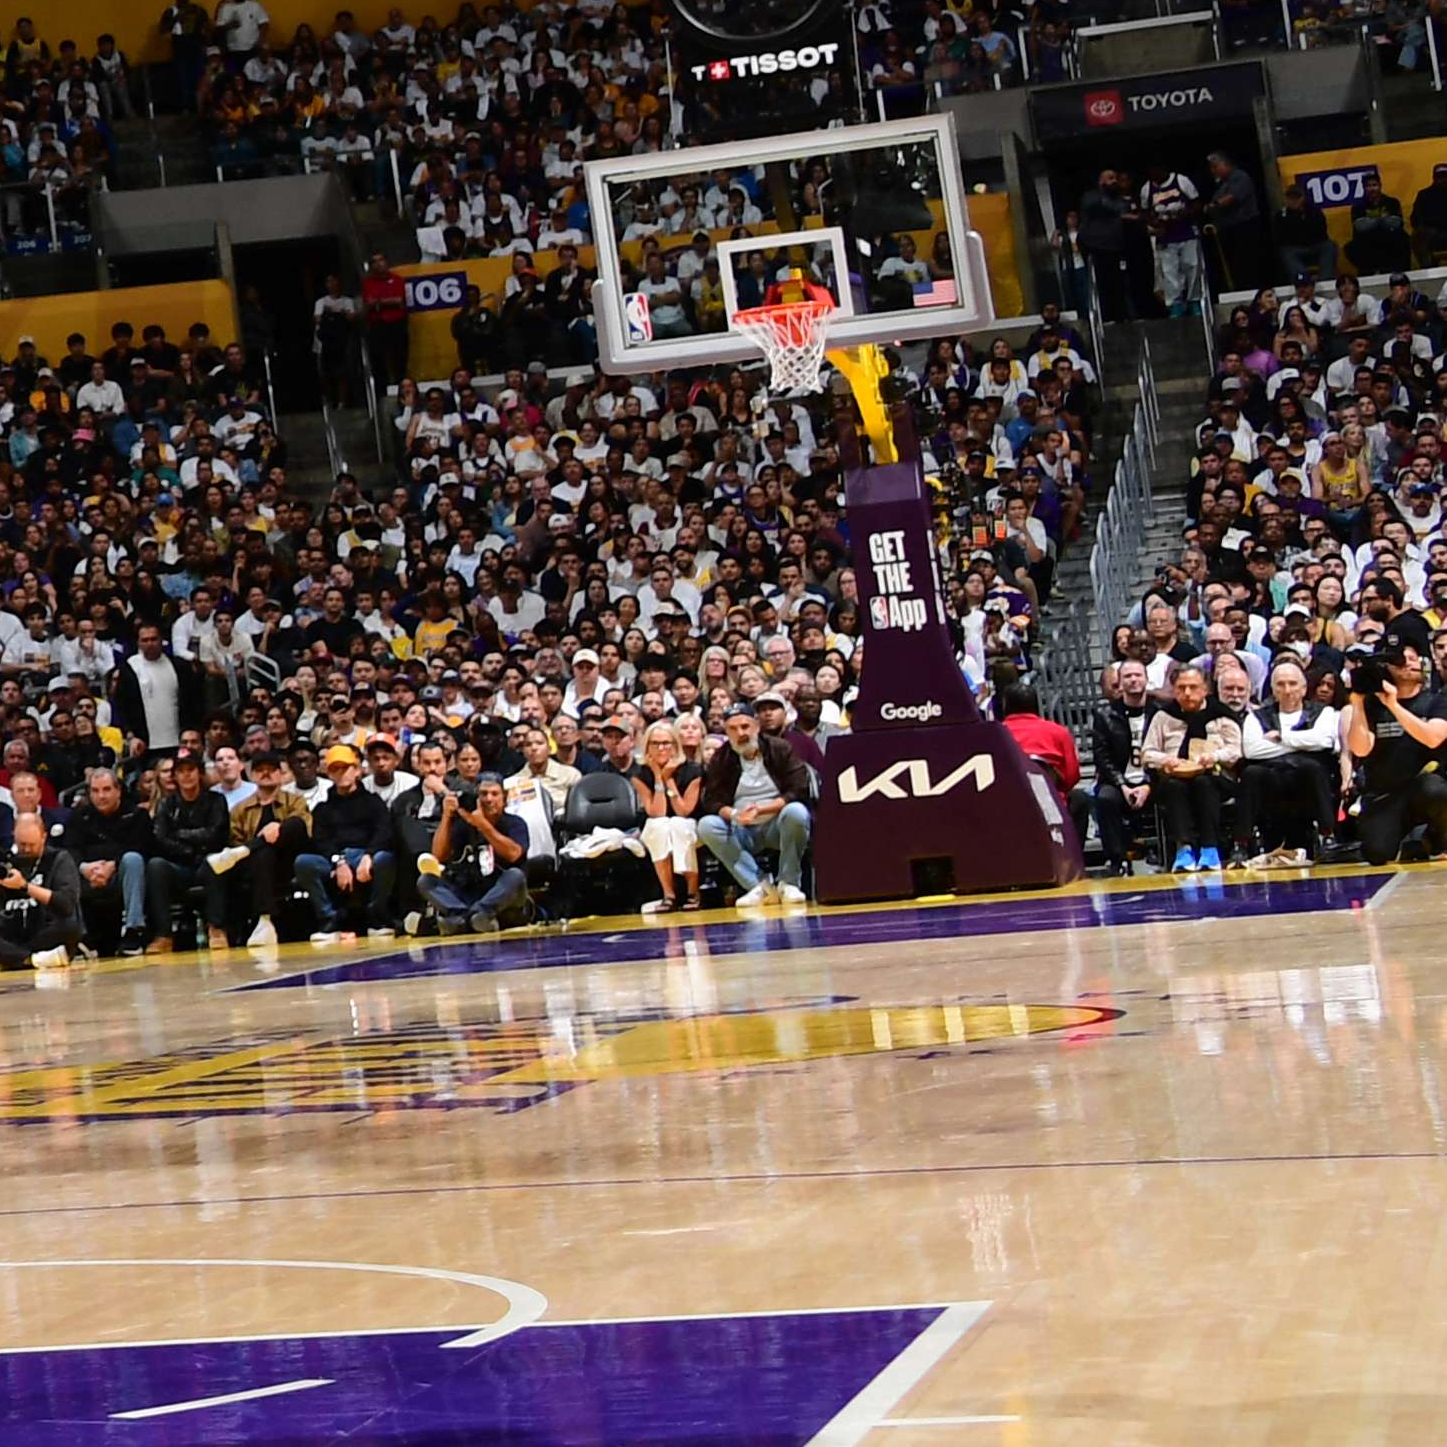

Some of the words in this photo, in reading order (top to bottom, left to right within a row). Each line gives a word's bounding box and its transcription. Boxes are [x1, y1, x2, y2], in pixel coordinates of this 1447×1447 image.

[730, 42, 840, 78] TISSOT
[1128, 86, 1214, 113] TOYOTA
[1306, 171, 1375, 204] 107
[405, 276, 461, 308] 106
[868, 530, 906, 563] GET
[872, 563, 914, 595] THE
[889, 596, 927, 632] App
[879, 700, 942, 722] Google
[837, 753, 996, 803] KIA
